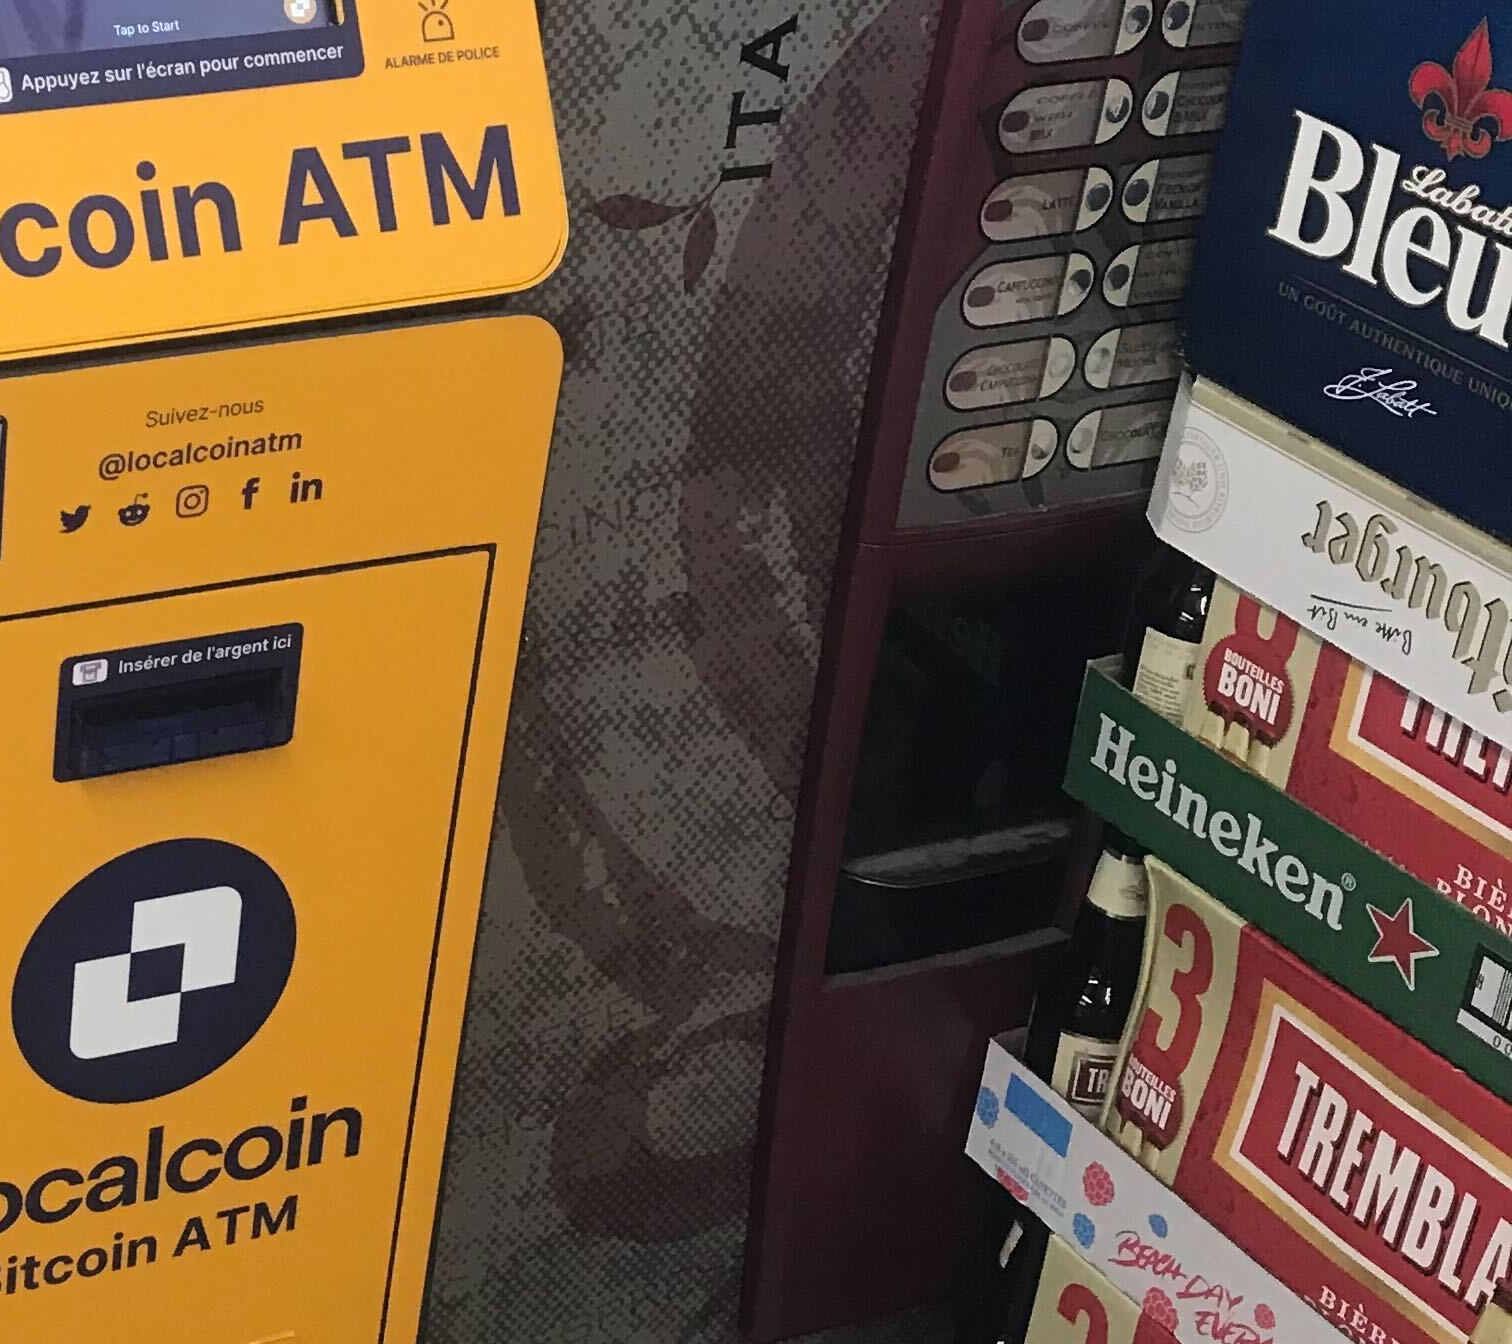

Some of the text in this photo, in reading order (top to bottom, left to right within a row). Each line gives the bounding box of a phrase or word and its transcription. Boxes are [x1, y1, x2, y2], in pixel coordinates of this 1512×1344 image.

[114, 20, 180, 38] Tap to Start
[21, 44, 345, 95] Appuyez sur l'écran pour commencer
[384, 46, 500, 69] ALARME DE POLICE
[277, 123, 522, 247] ATM
[1278, 280, 1299, 303] UN
[1303, 291, 1347, 326] GOÛT
[1348, 318, 1464, 386] AUTHENTIQUE
[145, 399, 265, 428] Suivez-nous
[98, 432, 303, 481] @localcoinatm
[118, 634, 292, 674] Insérer de l'argent ici
[1307, 605, 1412, 656] Bitte ein Bit
[1217, 662, 1281, 726] BONI
[1224, 647, 1285, 695] BOUTEILLES
[1089, 712, 1345, 931] Heineken
[1140, 903, 1214, 1052] 3
[1121, 1071, 1172, 1130] BONI
[172, 1194, 299, 1257] ATM
[1176, 1275, 1244, 1310] DAY
